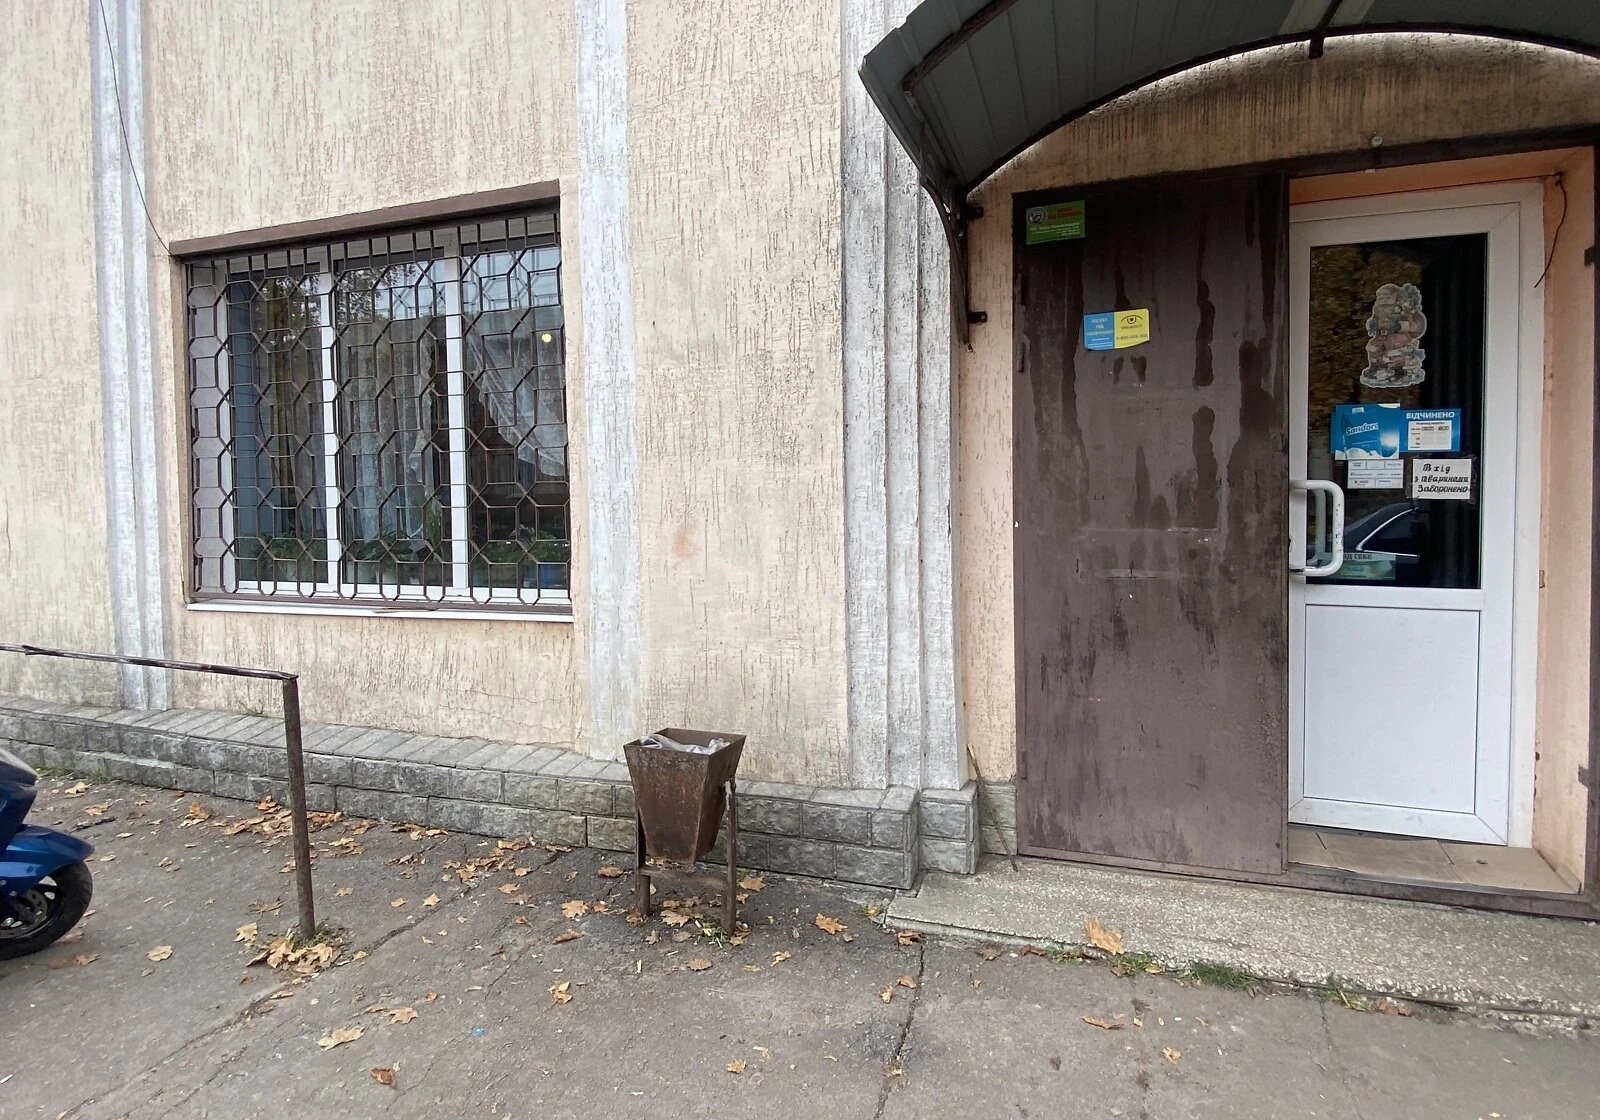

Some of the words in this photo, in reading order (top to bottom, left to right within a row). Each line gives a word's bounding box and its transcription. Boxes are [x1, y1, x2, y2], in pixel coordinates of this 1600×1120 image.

[1406, 412, 1455, 420] ВІДЧИНЕНО
[1423, 463, 1450, 474] Вхід
[1421, 475, 1468, 483] тваринами
[1418, 484, 1468, 493] Заборонено
